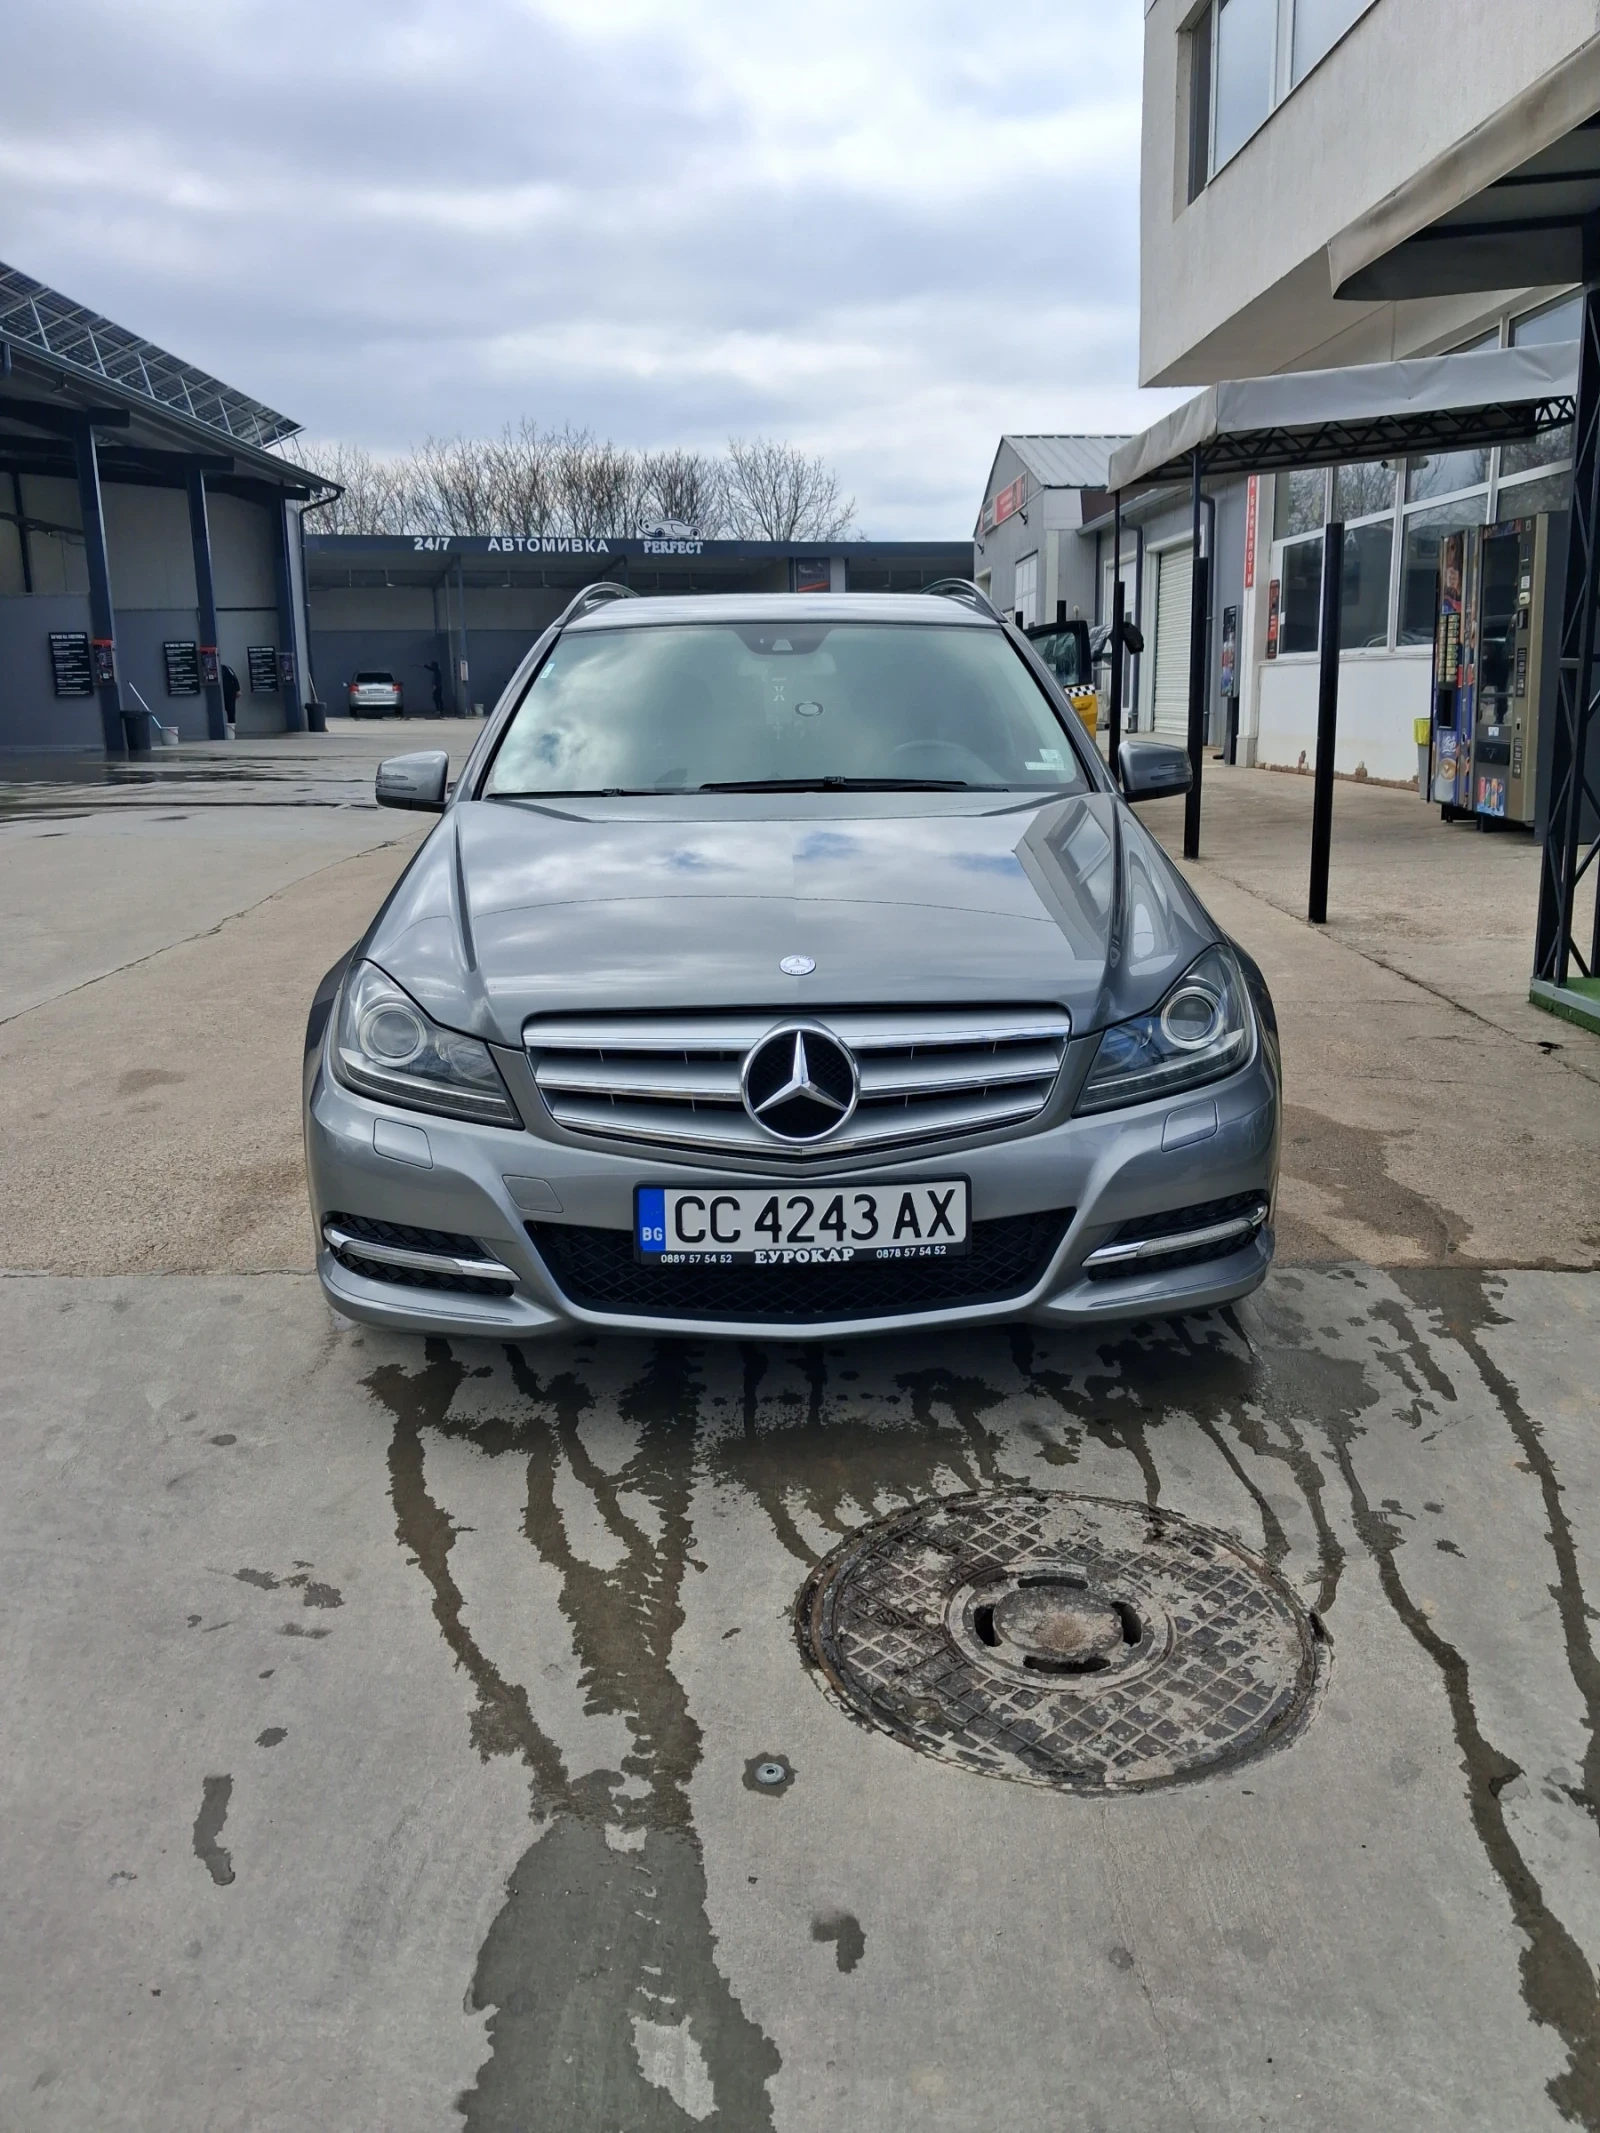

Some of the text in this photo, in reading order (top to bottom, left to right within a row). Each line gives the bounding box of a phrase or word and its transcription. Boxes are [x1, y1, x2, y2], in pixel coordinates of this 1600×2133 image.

[413, 537, 609, 553] 24/7 АВТОМИВКА
[643, 540, 703, 554] PERFECT
[674, 1188, 956, 1244] CC 4243 AX
[642, 1227, 663, 1242] BG
[660, 1254, 733, 1263] 0889 57 54 52
[754, 1248, 854, 1264] ЕУРОКАР
[876, 1245, 947, 1259] 0878 57 54 52
